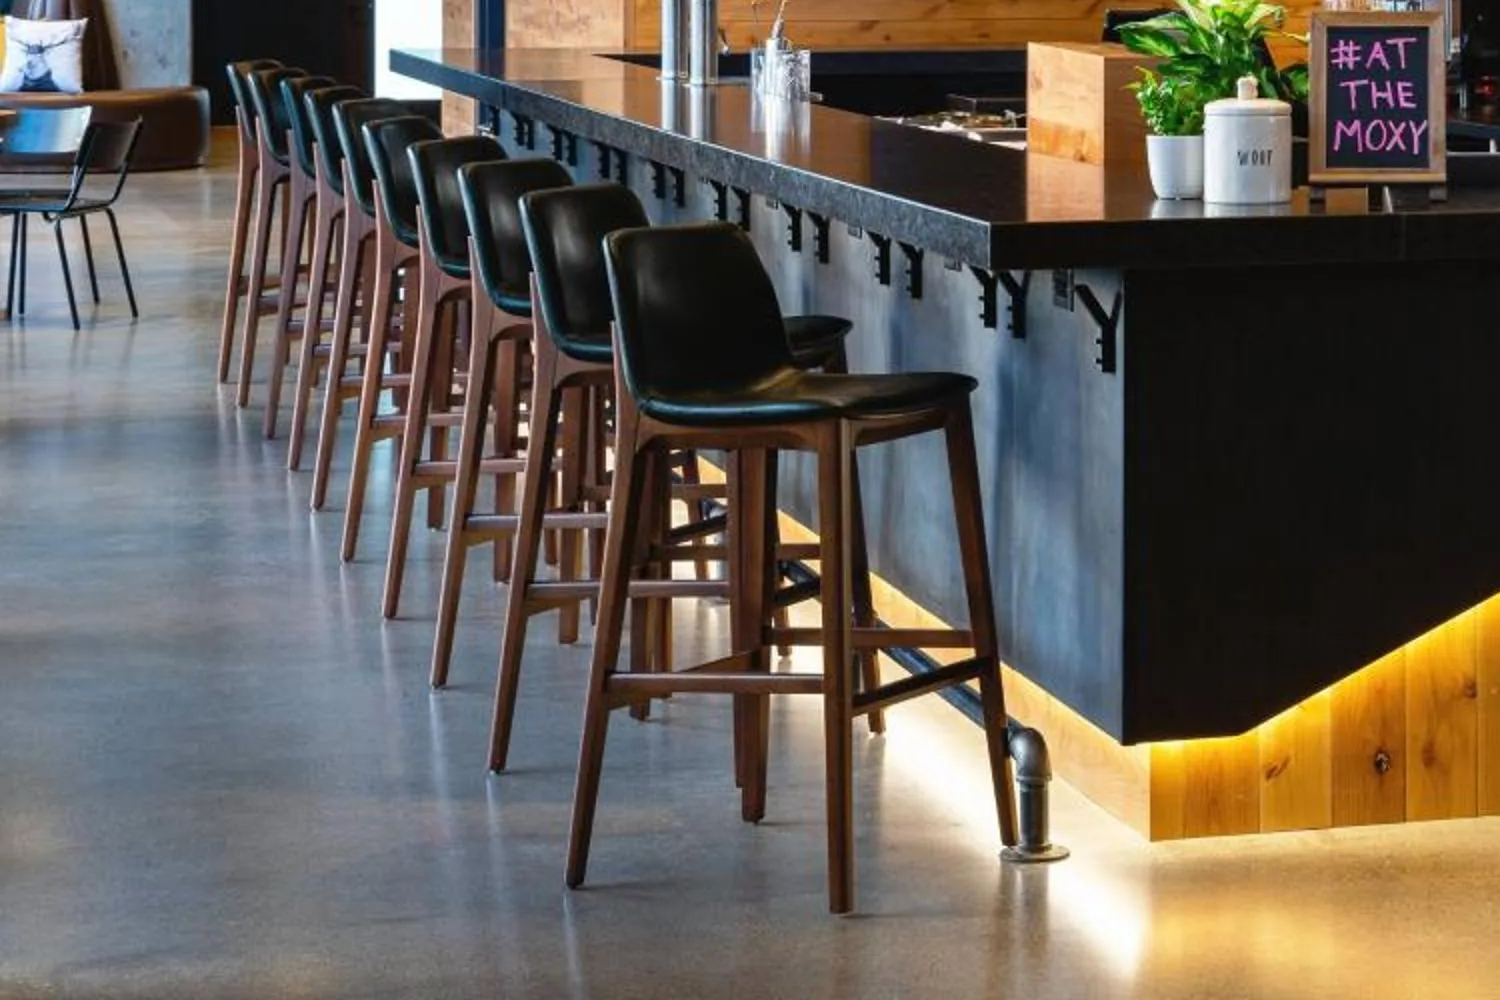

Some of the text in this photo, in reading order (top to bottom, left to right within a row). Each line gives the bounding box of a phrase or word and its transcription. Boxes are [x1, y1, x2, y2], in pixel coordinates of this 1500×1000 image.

[1330, 37, 1417, 71] #AT
[1340, 79, 1417, 110] THE
[1333, 119, 1428, 155] MOXY
